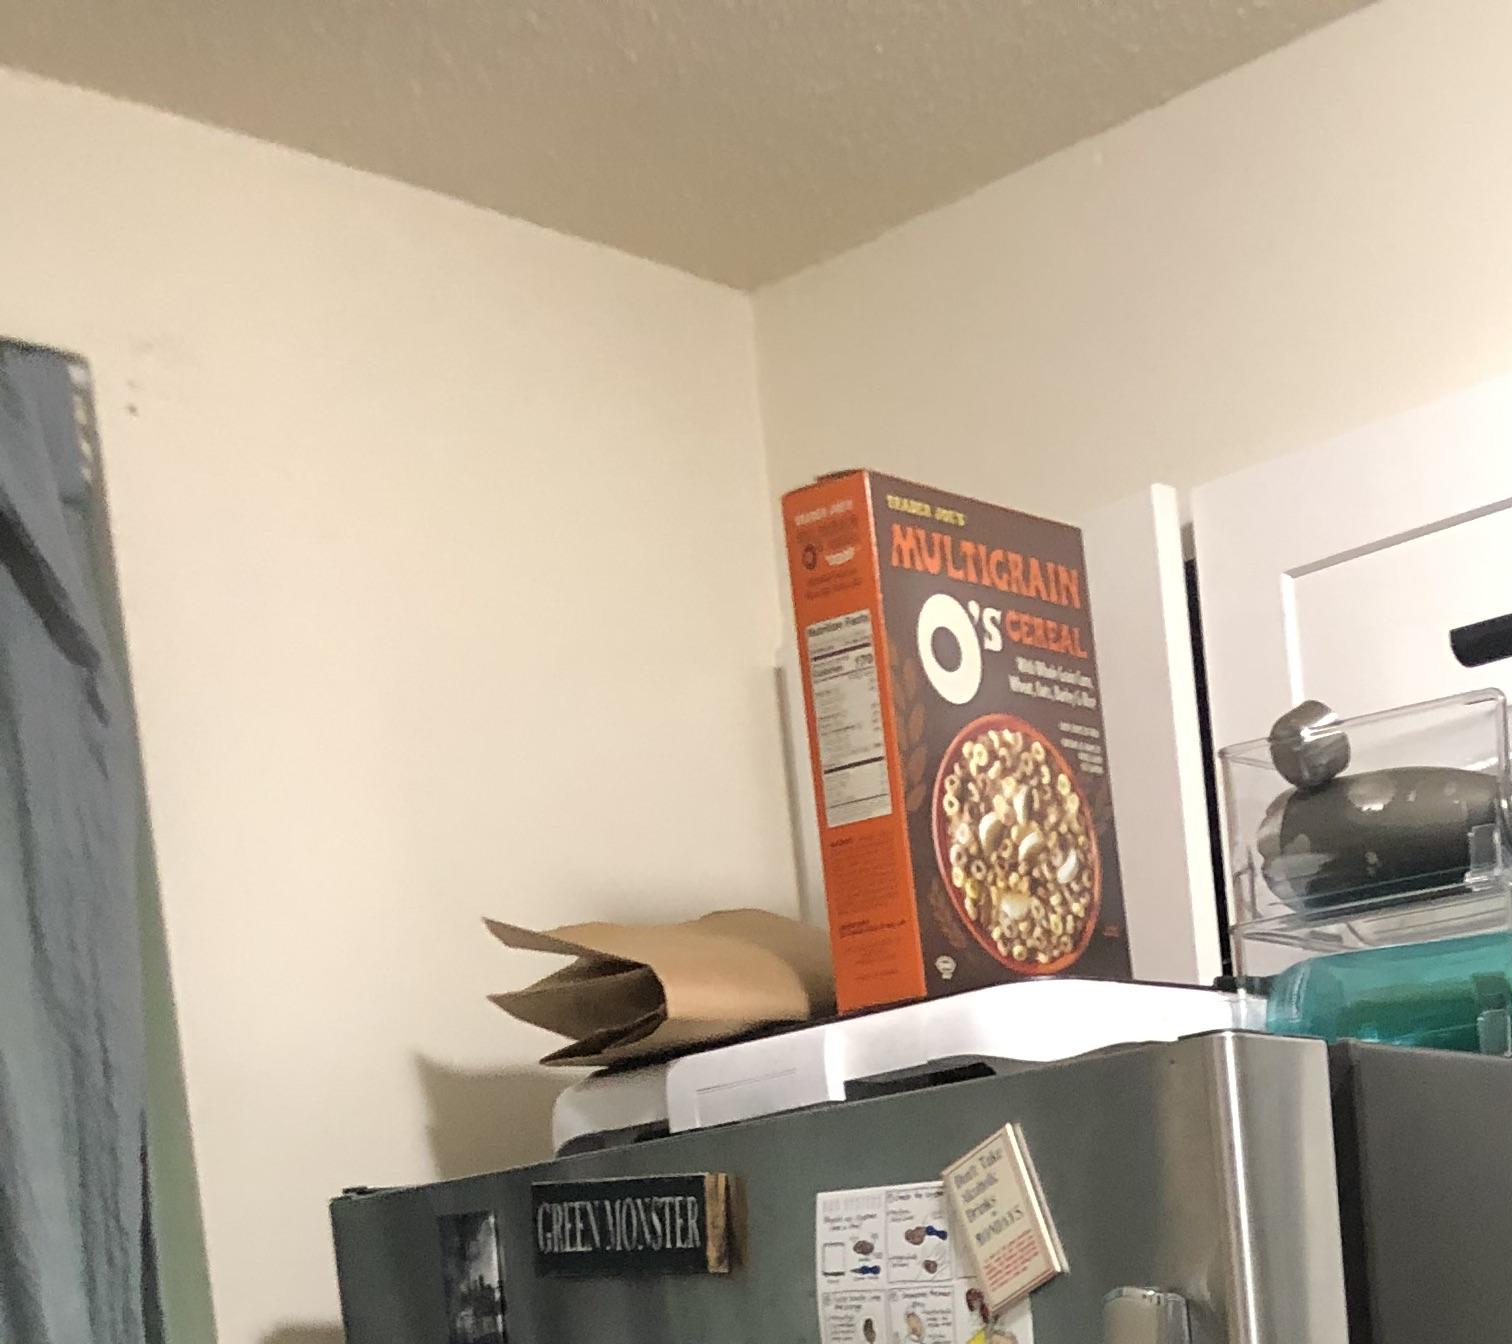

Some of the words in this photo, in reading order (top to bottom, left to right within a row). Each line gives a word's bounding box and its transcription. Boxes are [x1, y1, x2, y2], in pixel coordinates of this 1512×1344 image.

[890, 523, 1081, 609] MULTIGRAIN
[1005, 609, 1088, 659] CEREAL
[537, 1201, 602, 1254] GREEN
[604, 1196, 701, 1251] MONSTER
